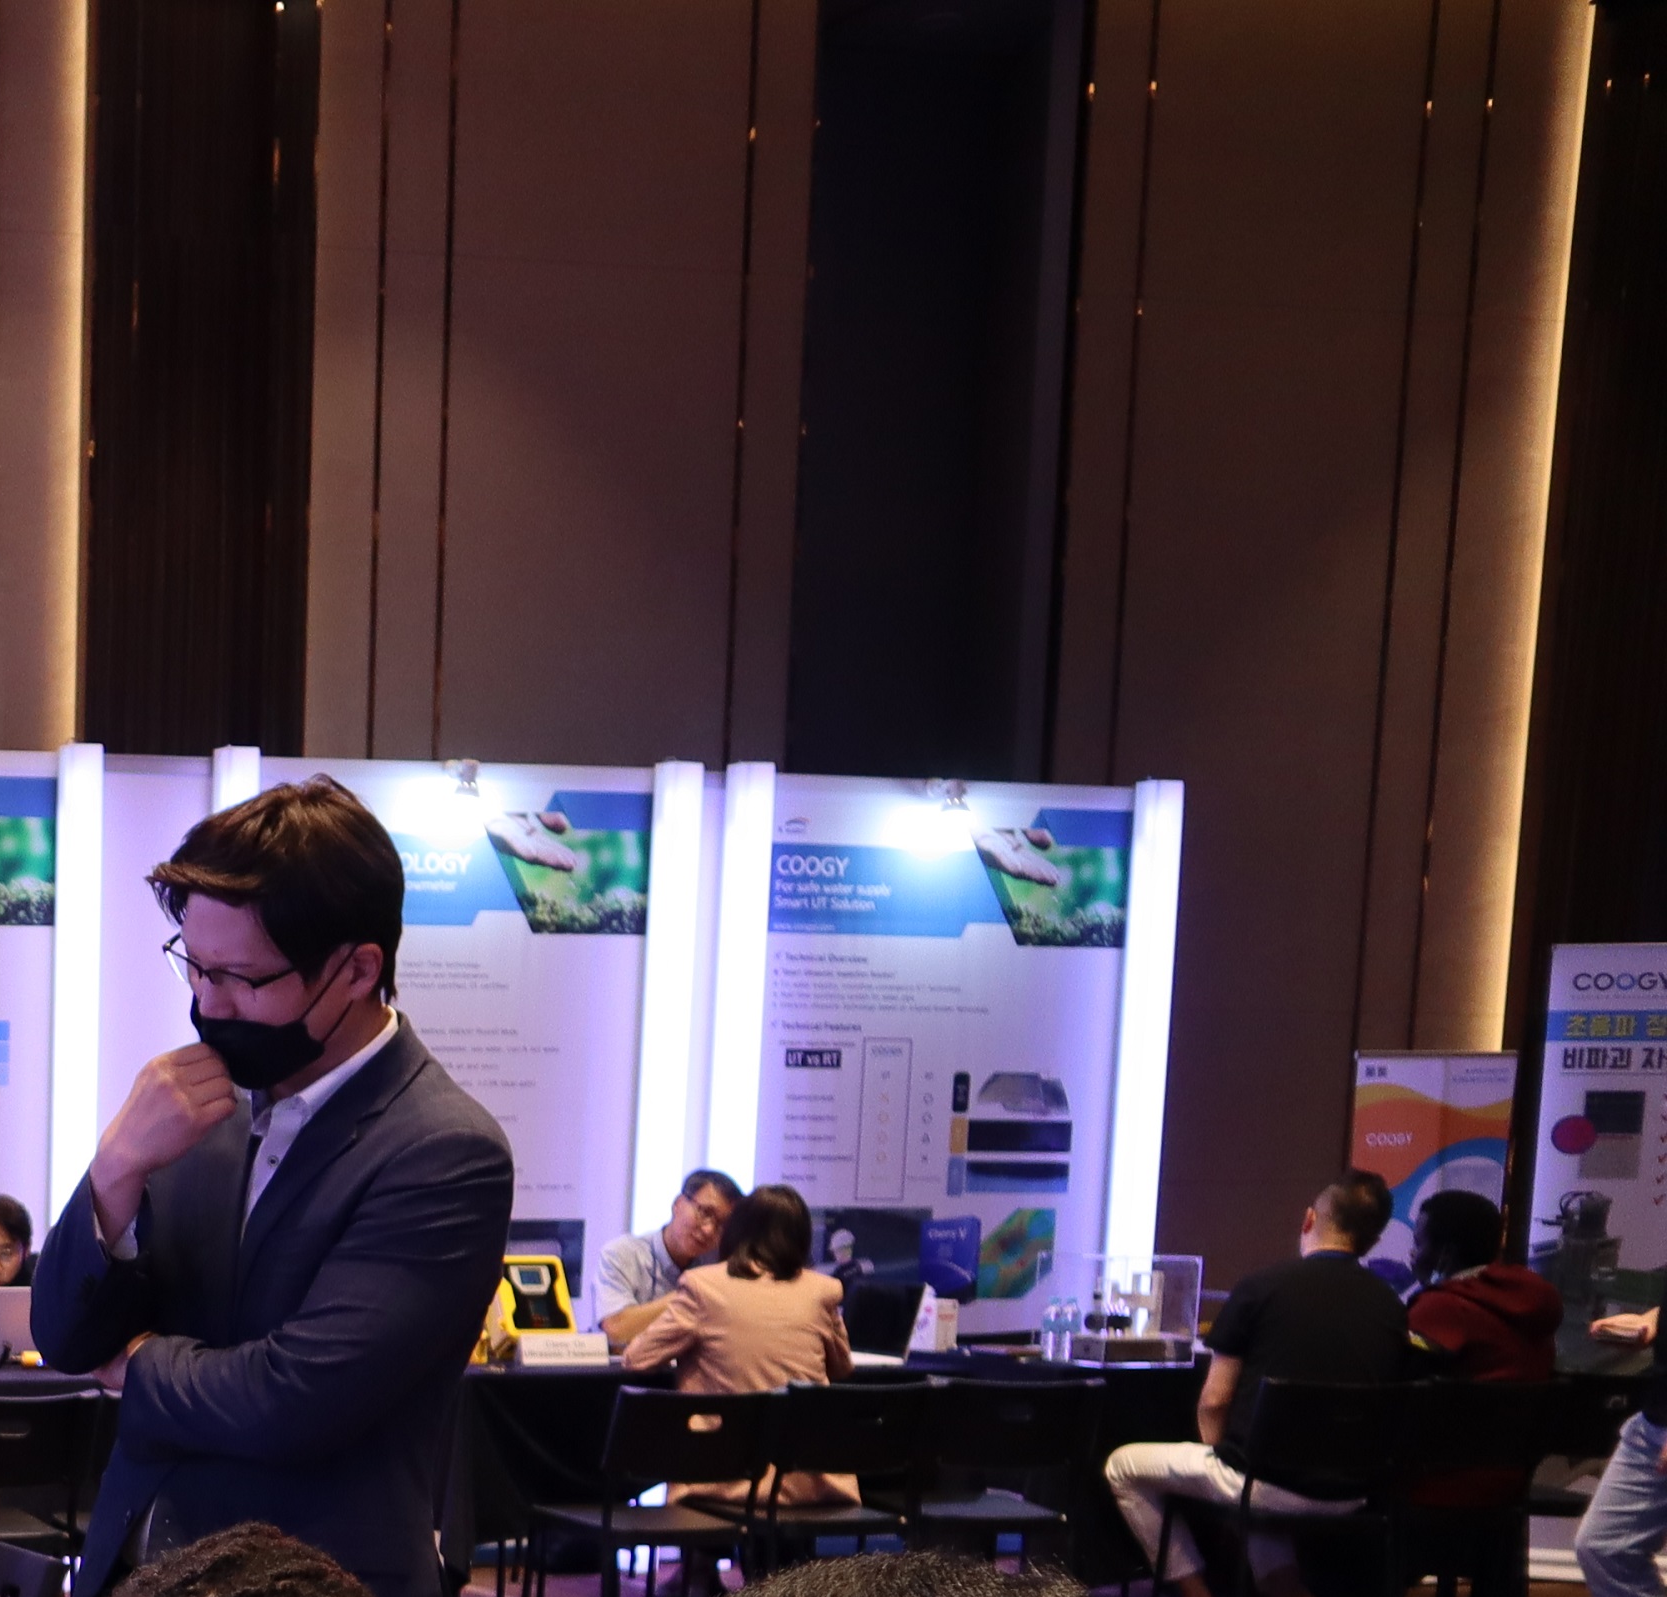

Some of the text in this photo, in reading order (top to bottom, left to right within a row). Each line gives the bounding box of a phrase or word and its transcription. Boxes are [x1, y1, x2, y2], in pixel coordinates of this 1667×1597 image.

[776, 853, 851, 878] COOGY
[775, 878, 795, 892] For
[796, 879, 821, 893] safe
[823, 881, 855, 895] water
[775, 894, 810, 909] Smart
[830, 895, 877, 912] Solution
